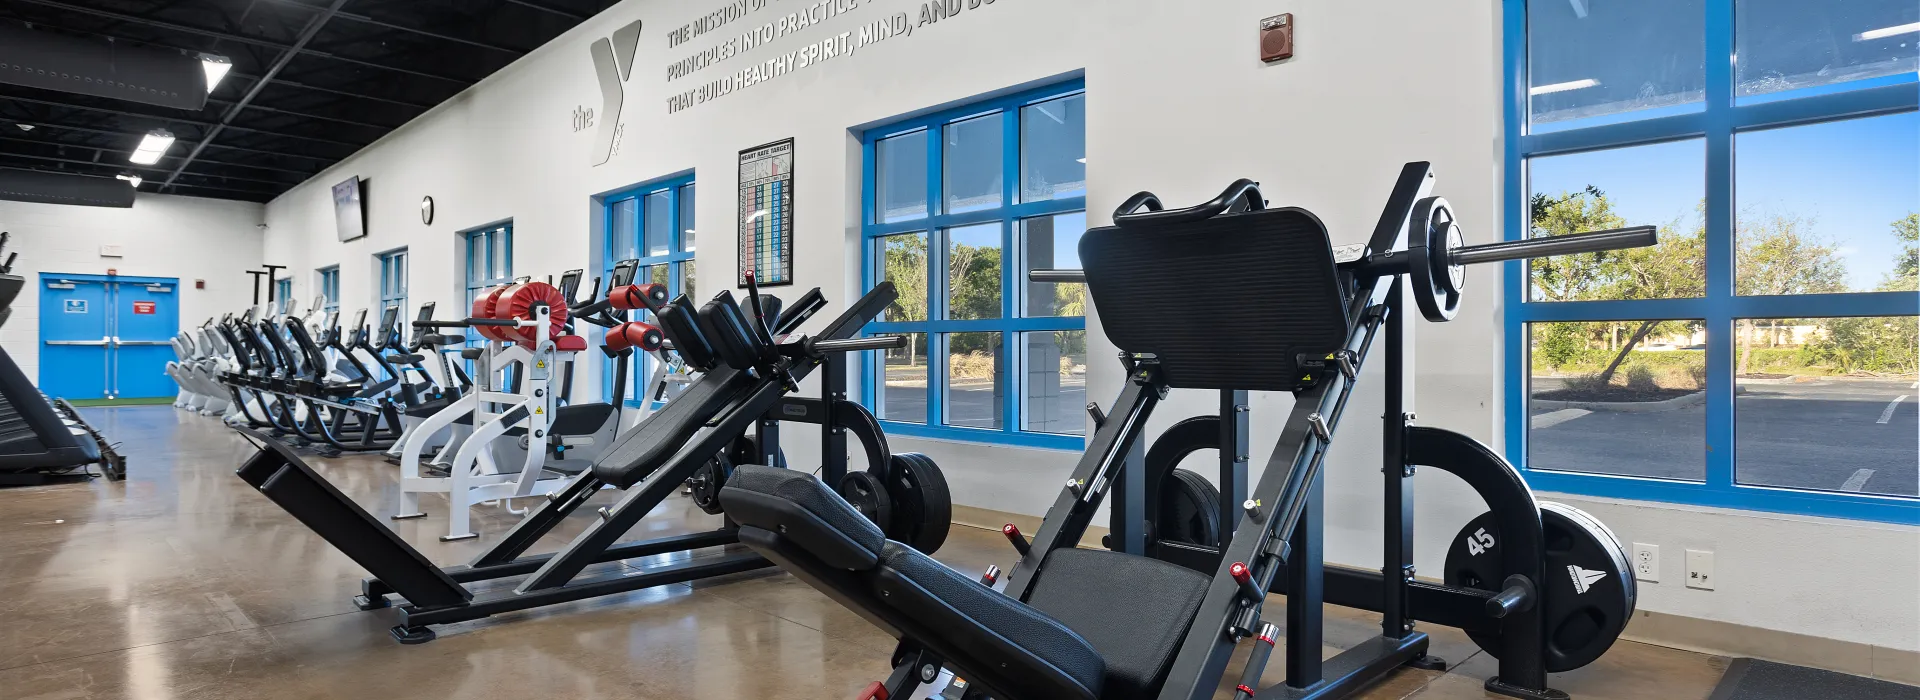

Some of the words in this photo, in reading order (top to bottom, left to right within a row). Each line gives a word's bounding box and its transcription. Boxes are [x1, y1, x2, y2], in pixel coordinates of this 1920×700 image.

[666, 24, 690, 49] THE
[693, 0, 747, 38] MISSION
[666, 88, 696, 115] THAT
[698, 75, 733, 105] BUILD
[735, 51, 798, 91] HEALTHY
[800, 31, 855, 69] SPIRIT,
[858, 12, 913, 48] MIND,
[917, 0, 962, 28] AND
[667, 37, 736, 83] PRINCIPLES
[740, 22, 775, 53] INTO
[572, 104, 594, 132] the
[741, 152, 756, 161] HEART
[757, 149, 770, 157] RATE
[770, 144, 790, 154] TARGET
[1467, 527, 1495, 556] 45
